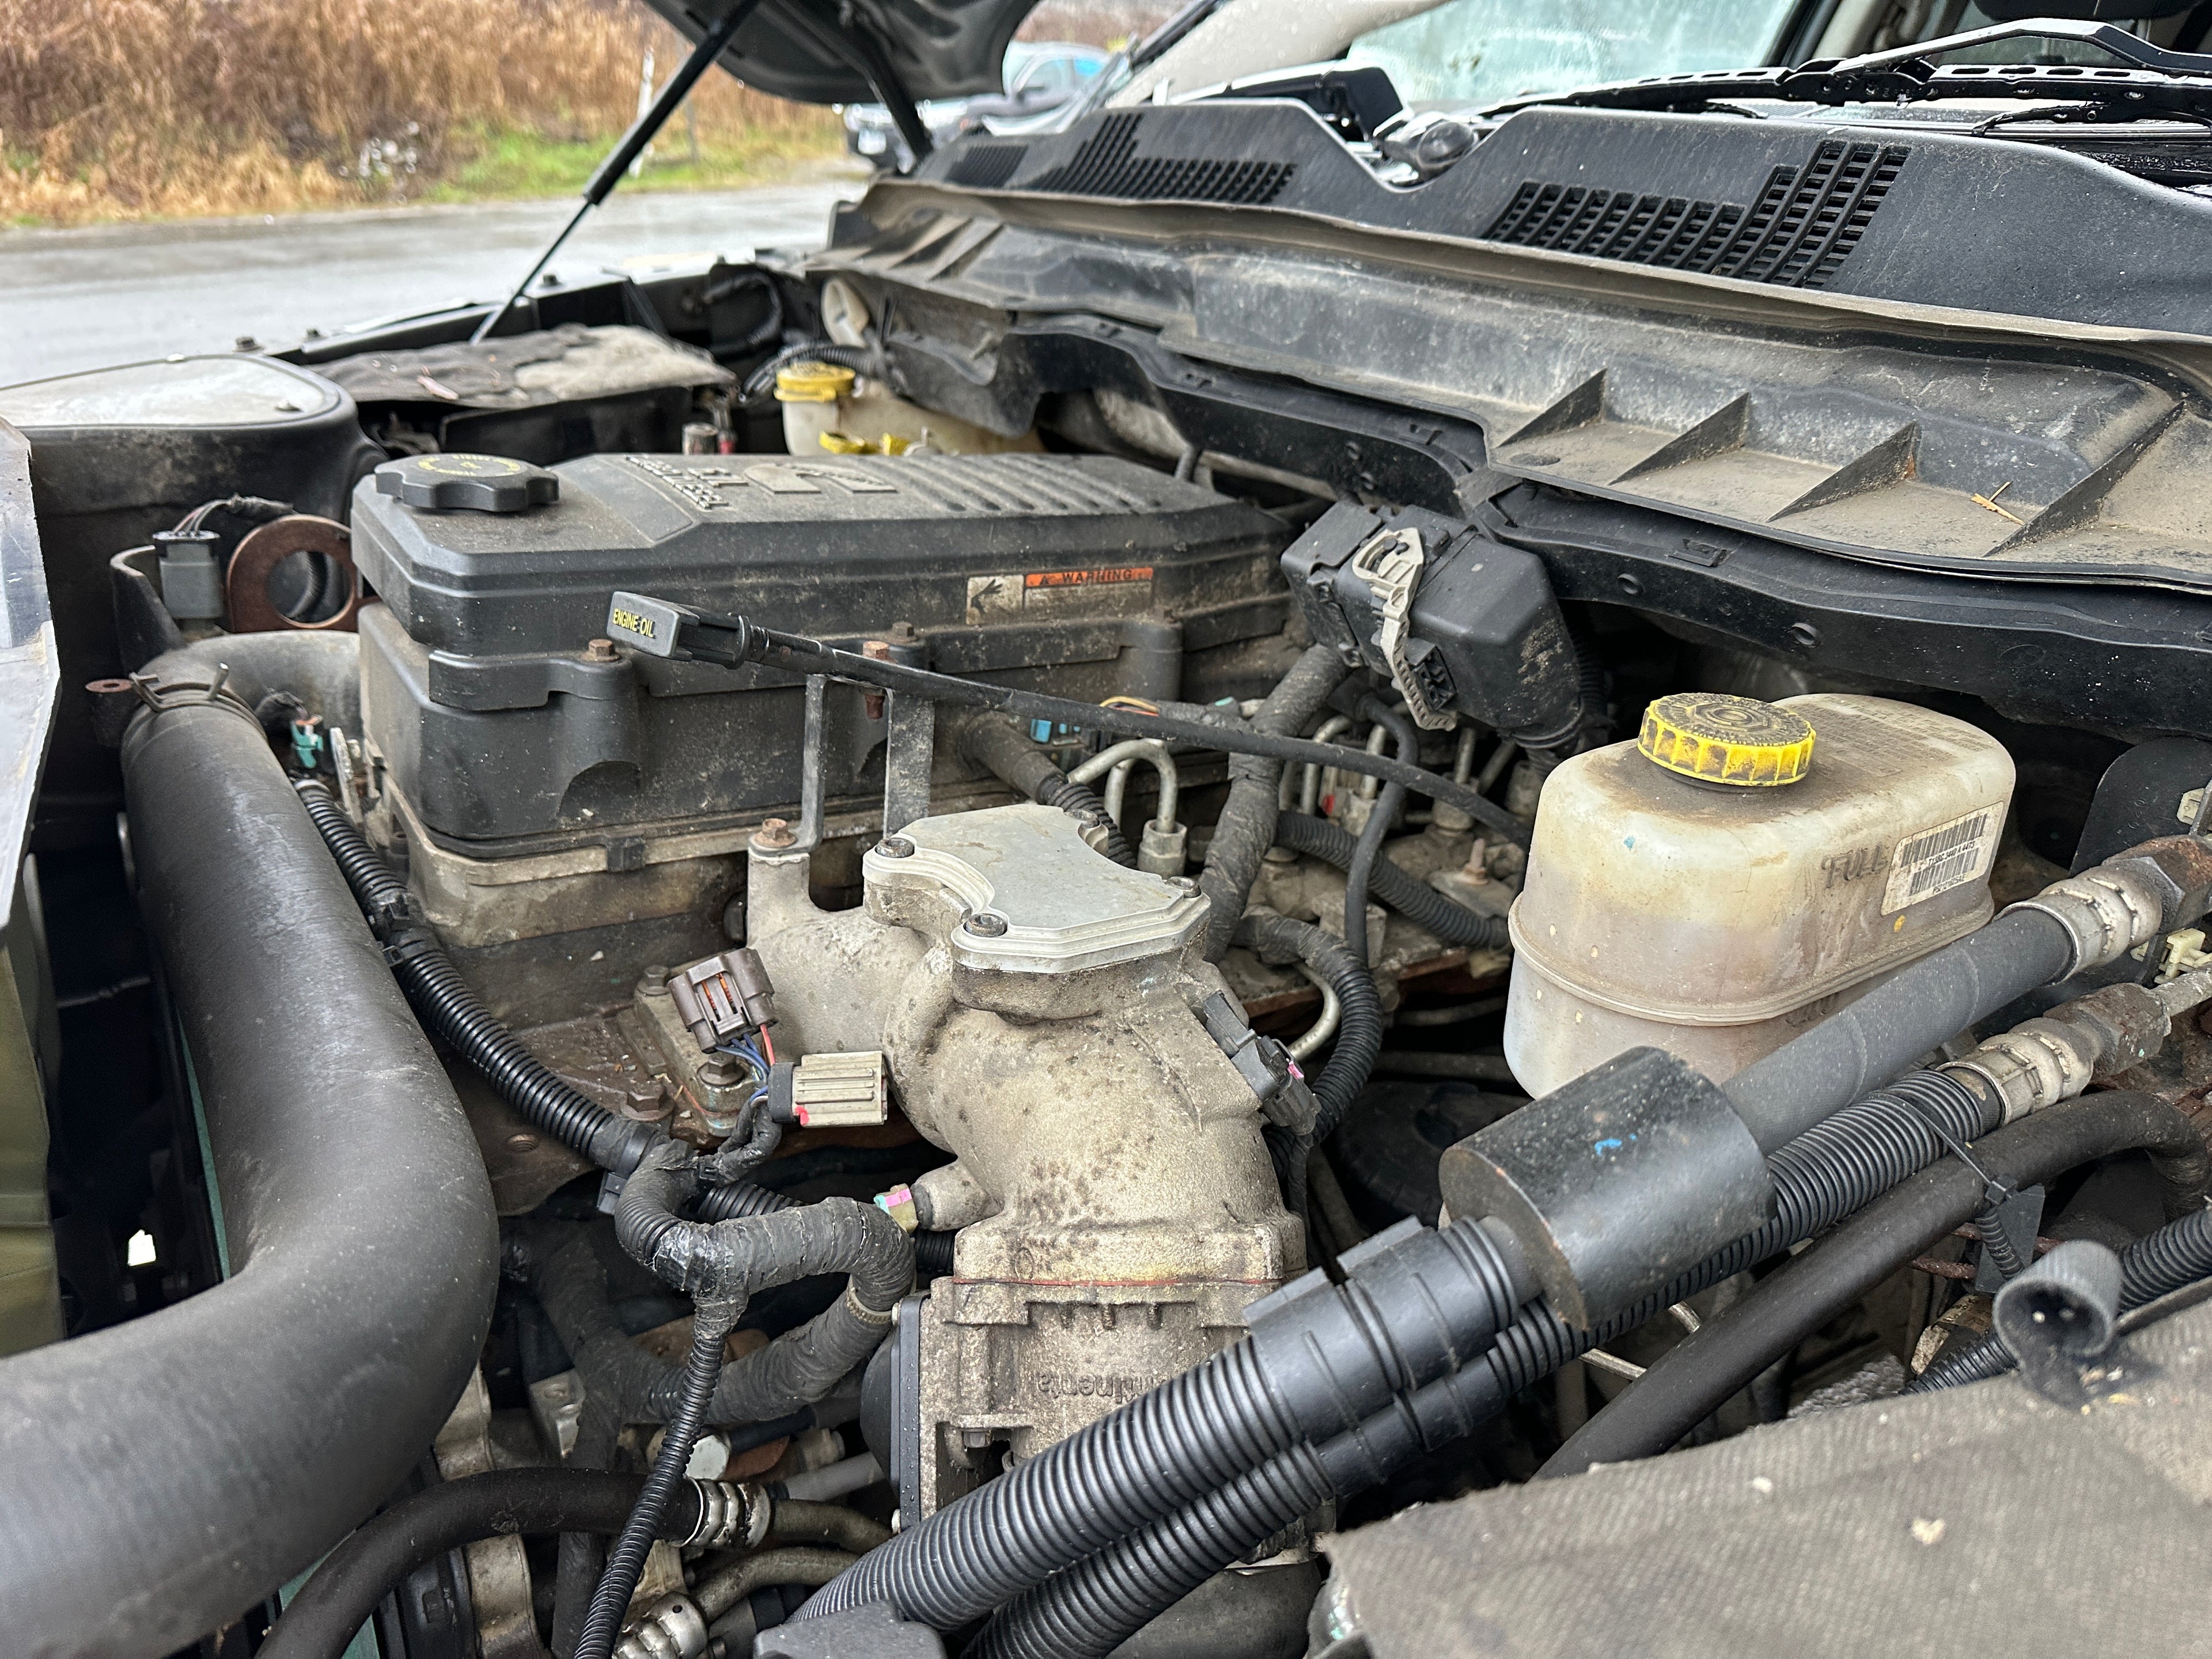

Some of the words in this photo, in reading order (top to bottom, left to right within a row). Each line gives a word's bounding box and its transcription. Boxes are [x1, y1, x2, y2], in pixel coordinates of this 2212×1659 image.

[1063, 569, 1132, 584] WARNING
[613, 608, 639, 632] ENGINE
[640, 618, 654, 638] OIL
[1821, 842, 1889, 888] FULL
